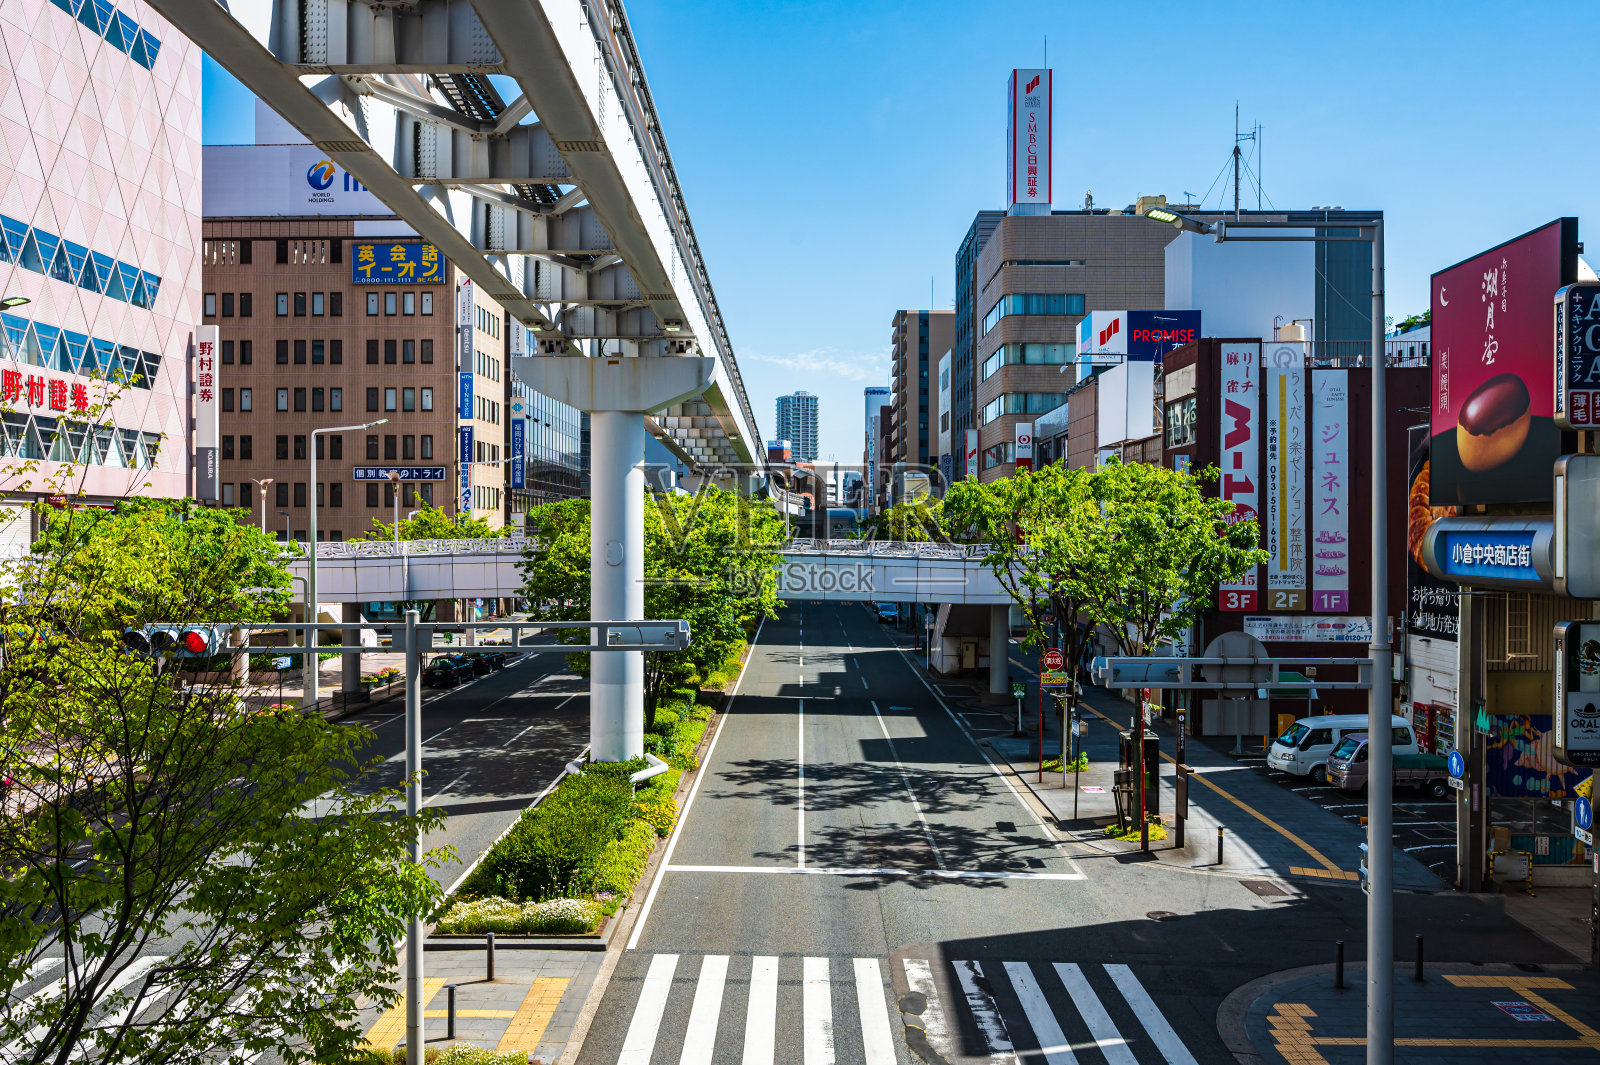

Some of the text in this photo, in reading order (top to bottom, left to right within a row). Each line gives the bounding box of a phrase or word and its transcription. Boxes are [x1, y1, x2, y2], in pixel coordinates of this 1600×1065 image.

[1027, 112, 1038, 198] SMBC日興証券
[358, 244, 439, 262] 英会話
[357, 260, 440, 278] イーオン
[1482, 267, 1499, 366] 湖月堂
[1133, 329, 1195, 342] PROMISE
[199, 341, 213, 402] 野村證券
[1226, 352, 1240, 394] 麻雀
[1241, 352, 1254, 394] リーチ
[1, 369, 89, 411] 野村證券
[1573, 394, 1588, 421] 薄毛
[1321, 423, 1340, 516] ジュネス
[1452, 543, 1531, 567] 小倉中央商店街
[1226, 592, 1251, 608] 3F
[1275, 591, 1299, 608] 2F
[1321, 593, 1341, 609] 1F
